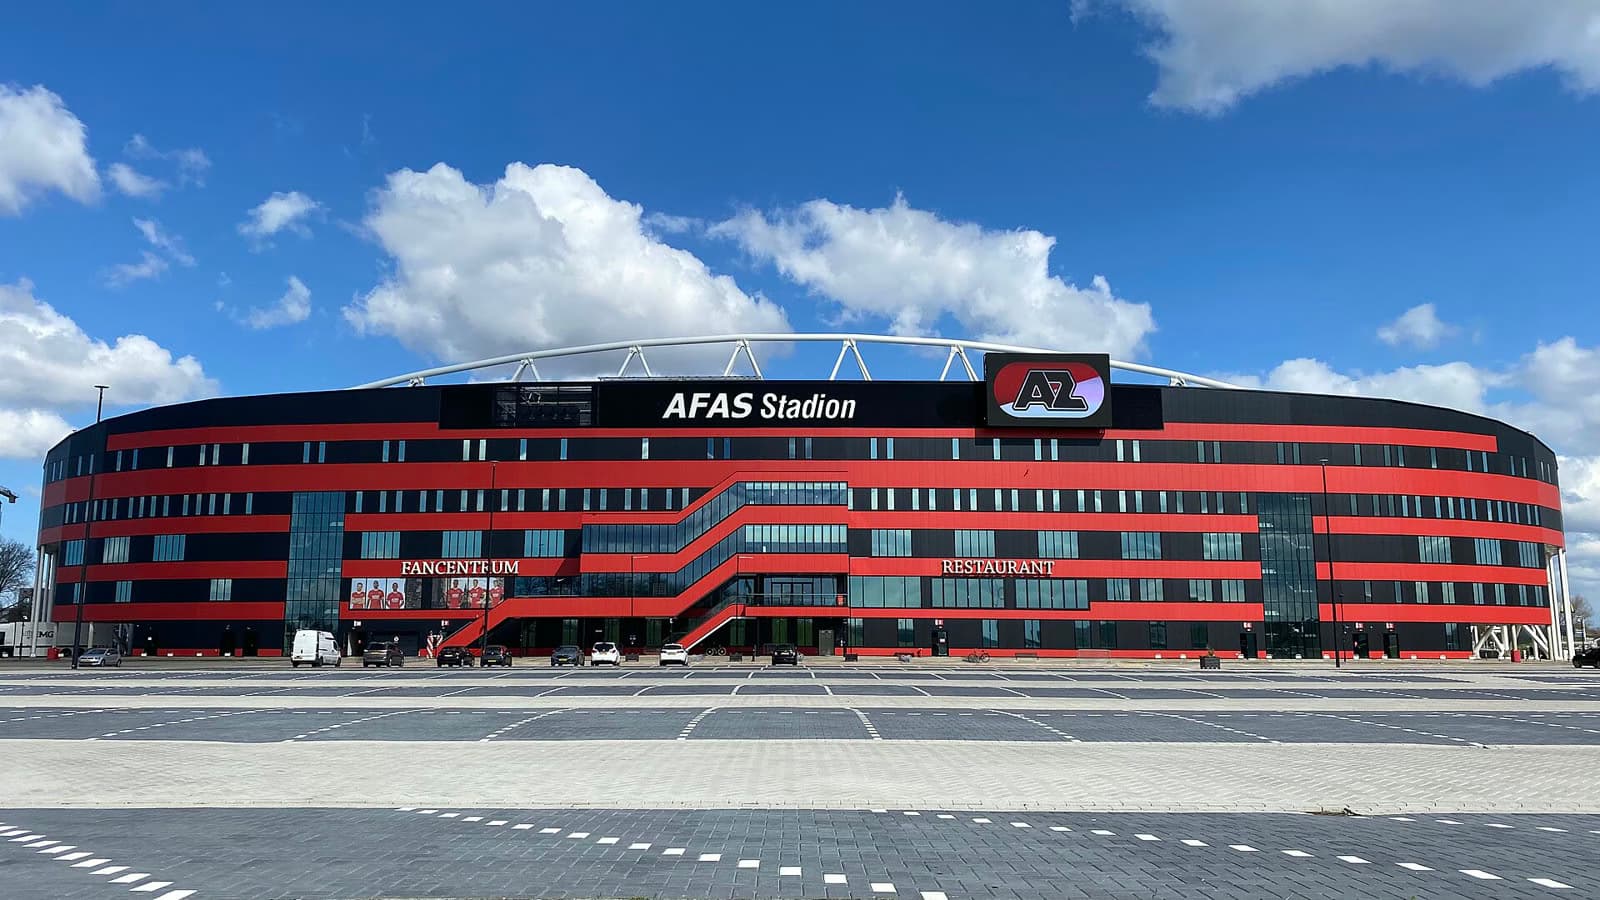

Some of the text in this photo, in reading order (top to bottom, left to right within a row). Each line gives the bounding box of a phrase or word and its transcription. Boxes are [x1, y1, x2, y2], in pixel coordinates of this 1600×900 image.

[1012, 369, 1088, 411] AZ
[662, 392, 856, 419] AFAS Stadion
[401, 560, 519, 575] FANCENTRUM
[943, 560, 1055, 575] RESTAURANT
